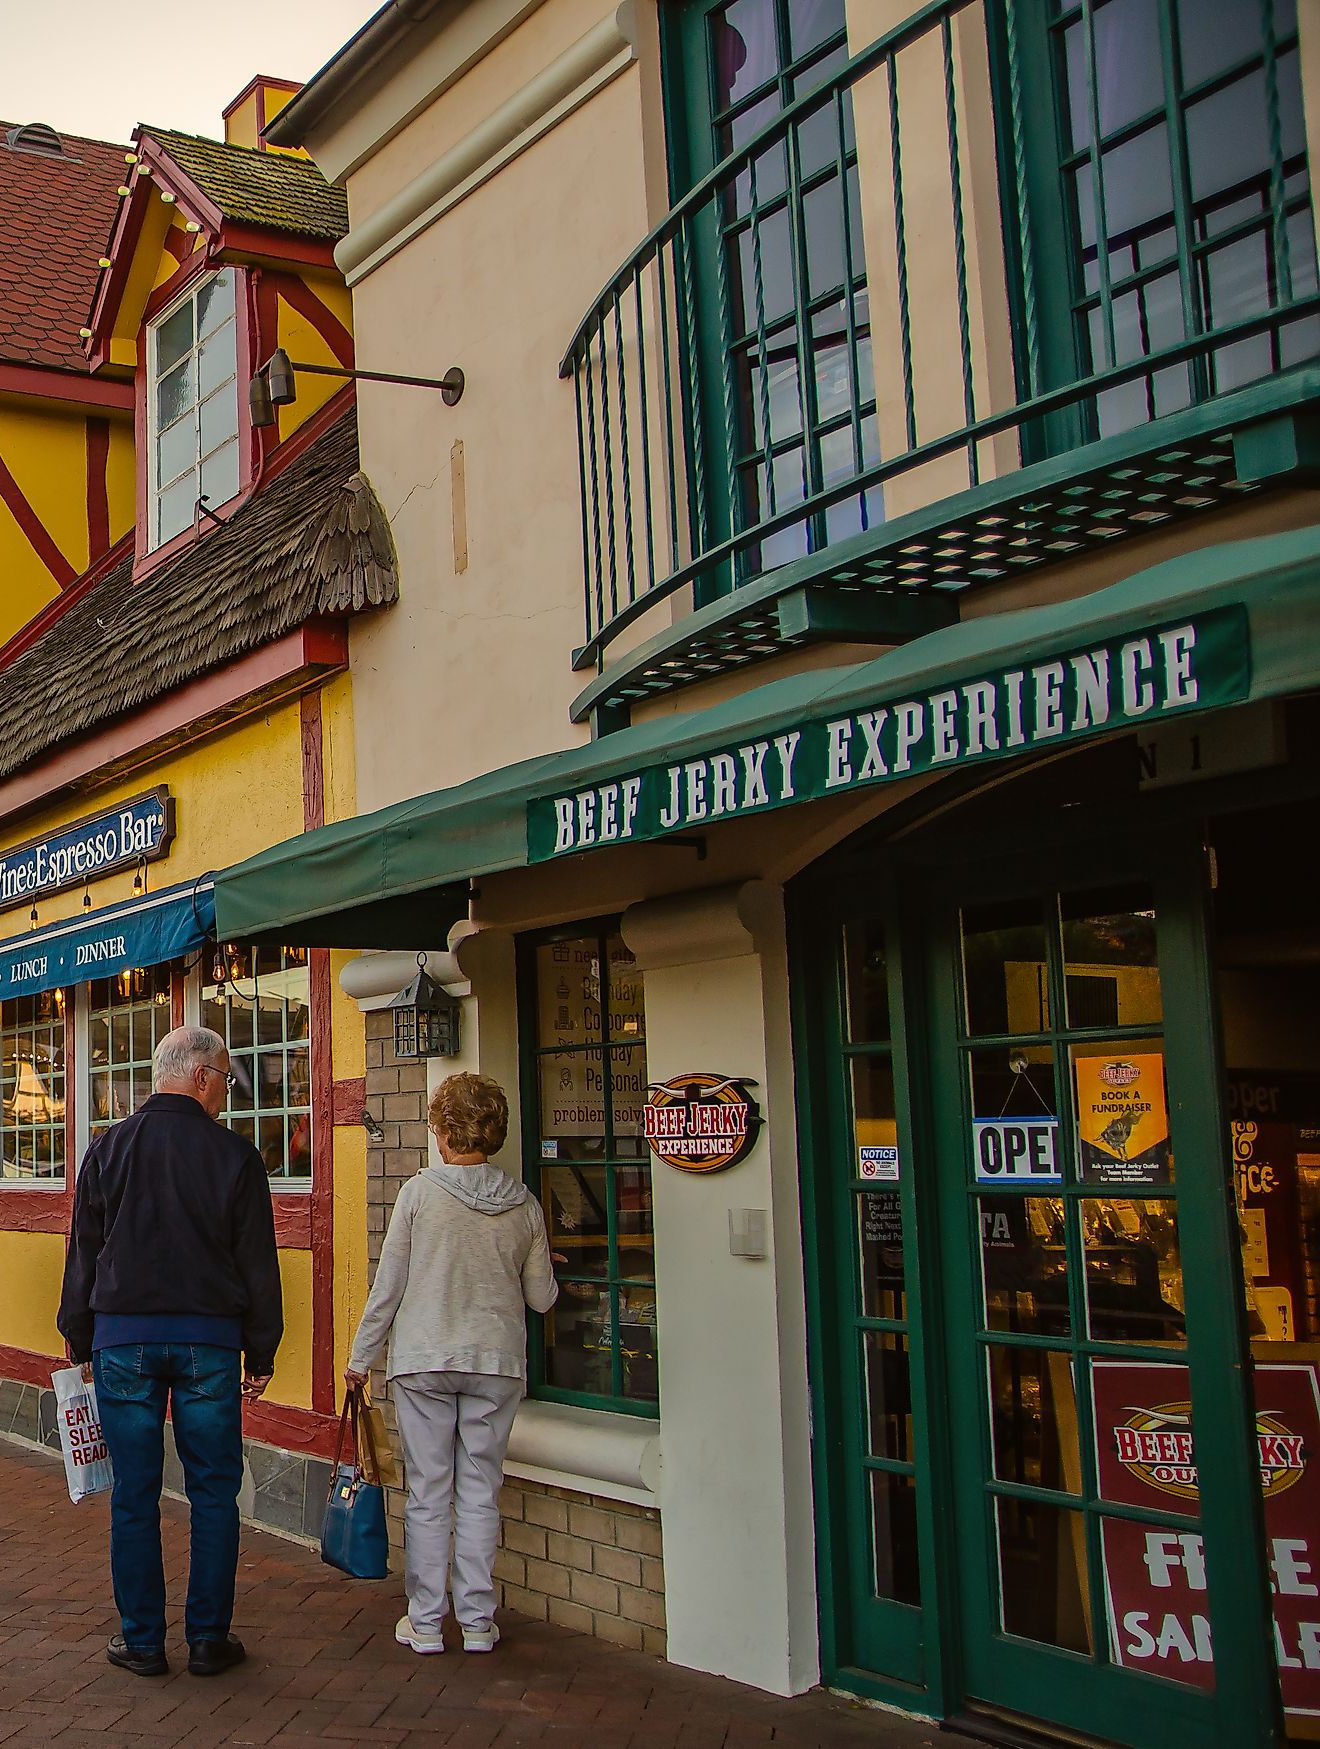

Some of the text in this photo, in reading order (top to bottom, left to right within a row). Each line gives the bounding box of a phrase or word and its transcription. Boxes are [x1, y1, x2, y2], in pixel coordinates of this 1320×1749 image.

[553, 623, 1200, 853] BEEF JERKY EXPERIENCE
[119, 811, 157, 857] Bar
[10, 956, 48, 983] LUNCH
[76, 935, 127, 966] DINNER
[584, 1006, 646, 1031] Coporate
[585, 1037, 633, 1067] Hoday
[586, 1068, 645, 1092] Pesonal
[1092, 1102, 1152, 1113] FUNDRAISER
[1101, 1091, 1141, 1101] BOOK A
[614, 1106, 645, 1122] solv
[643, 1101, 748, 1138] BEEF JERKY
[658, 1138, 734, 1155] EXPERIENCE
[861, 1149, 896, 1160] NOTICE
[979, 1126, 1062, 1177] OPE
[868, 1201, 881, 1211] For
[883, 1201, 893, 1211] All
[69, 1424, 105, 1447] SLEE
[1114, 1426, 1193, 1465] BEEF
[1143, 1532, 1318, 1597] FE
